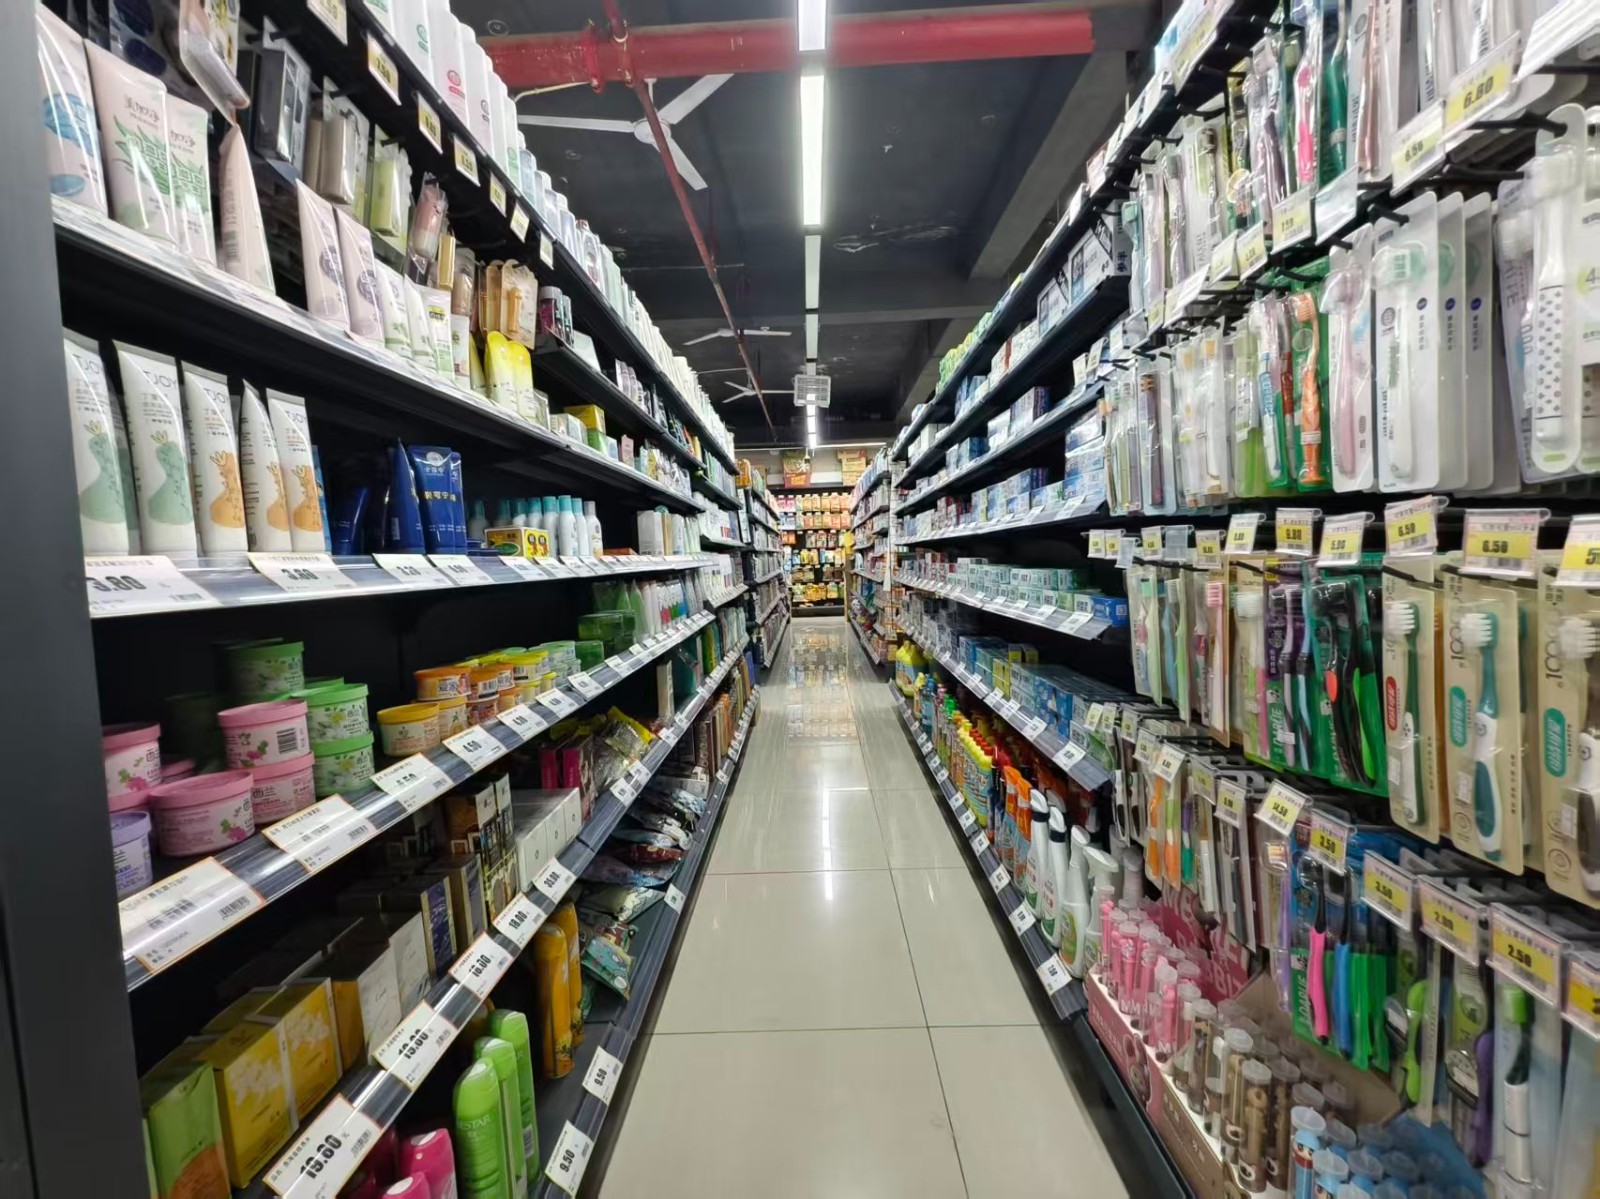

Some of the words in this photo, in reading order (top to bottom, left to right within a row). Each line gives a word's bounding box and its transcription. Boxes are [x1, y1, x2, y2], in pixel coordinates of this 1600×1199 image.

[1398, 523, 1416, 537] 6.50
[1482, 540, 1508, 554] 6.50
[1507, 944, 1531, 968] 2.50
[594, 1068, 608, 1086] 9.50
[560, 1149, 575, 1172] 9.50
